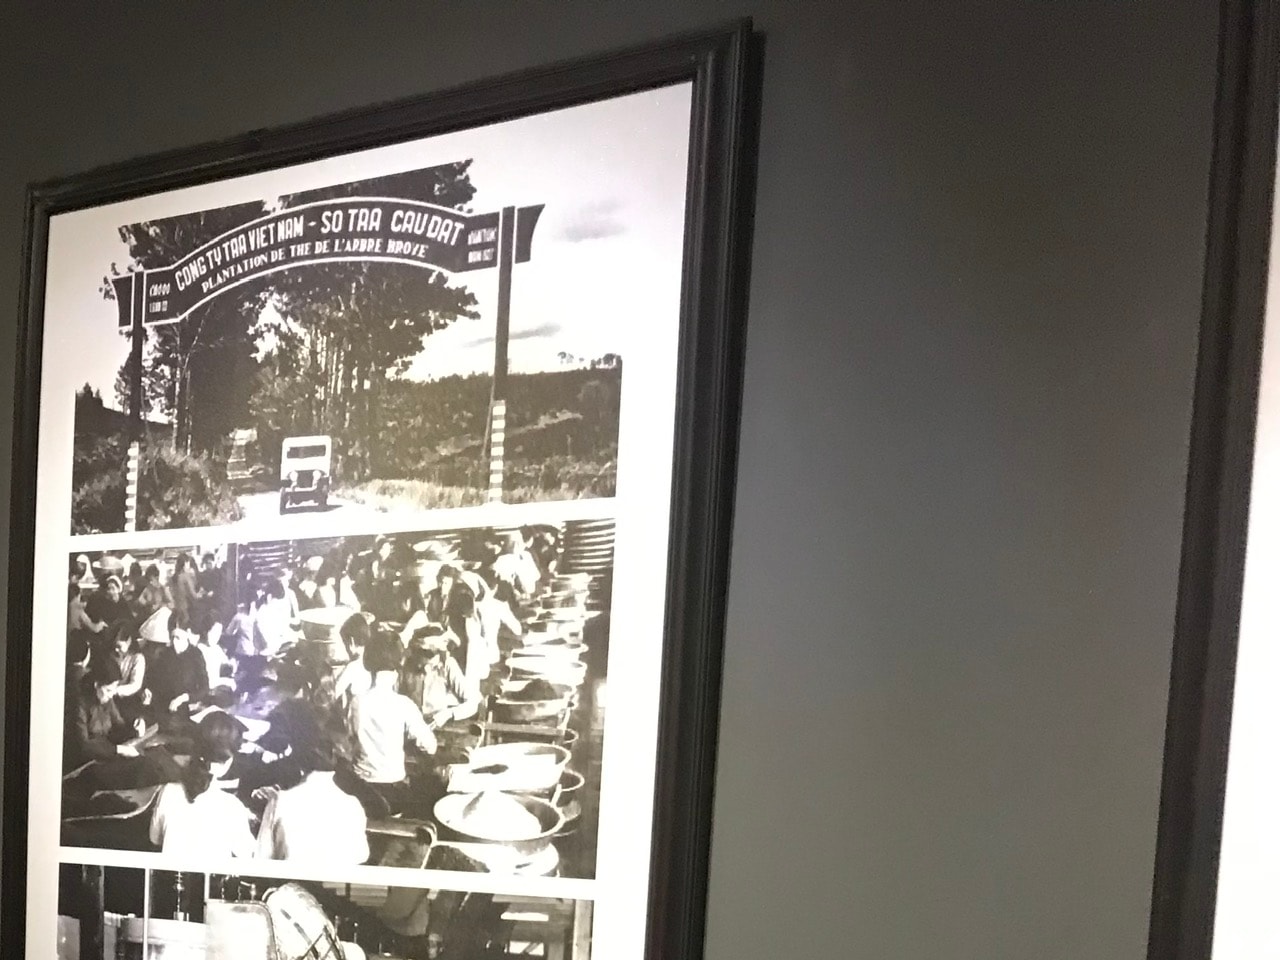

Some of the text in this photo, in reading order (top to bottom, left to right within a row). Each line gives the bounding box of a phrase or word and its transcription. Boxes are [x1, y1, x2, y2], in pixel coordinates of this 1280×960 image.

[175, 258, 207, 291] CONG
[206, 247, 223, 270] TY
[320, 209, 343, 234] SO
[201, 252, 268, 293] PLANTATION
[270, 247, 286, 263] DE
[289, 242, 312, 257] THE
[314, 239, 330, 254] DE
